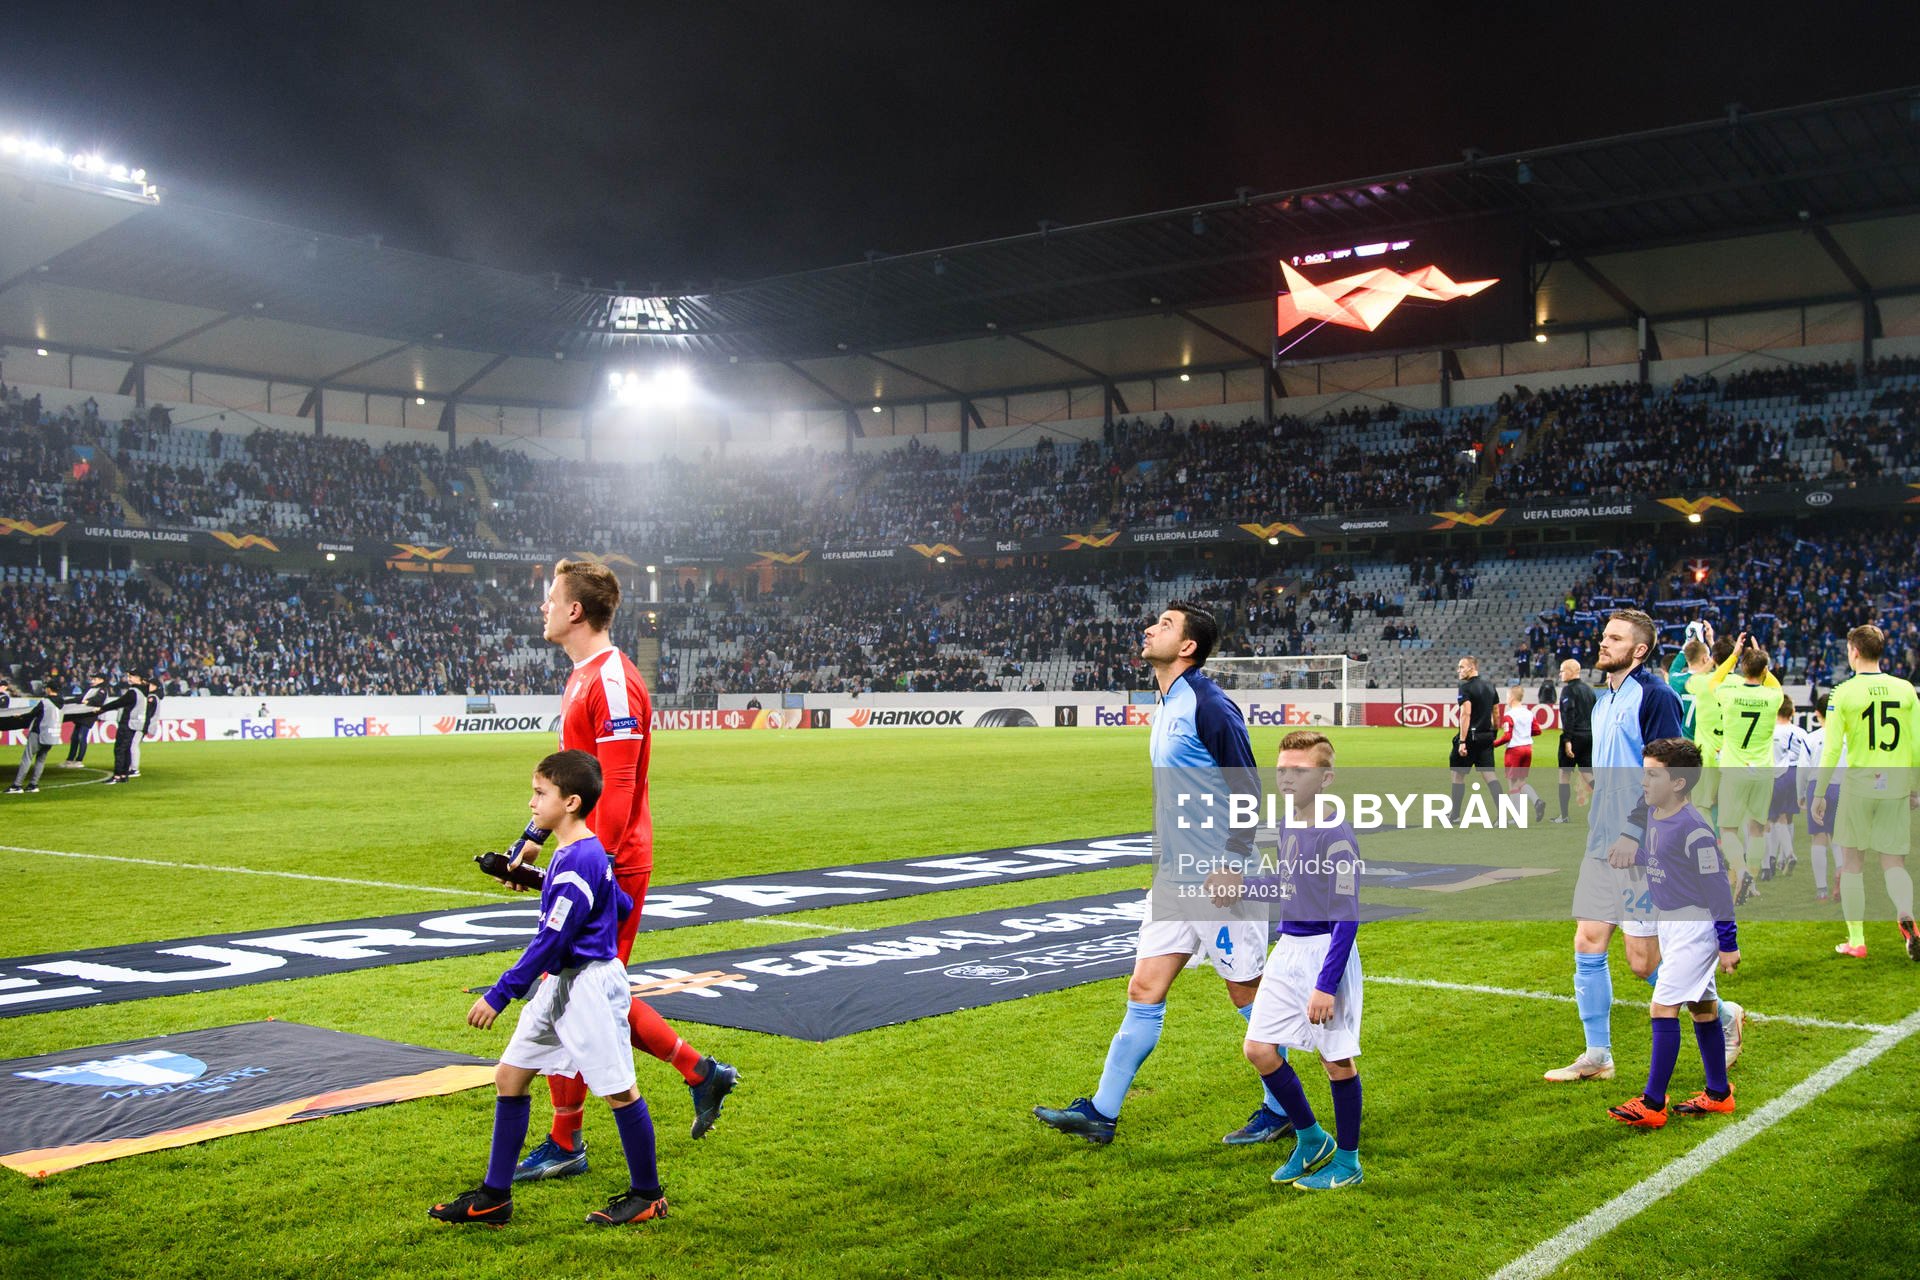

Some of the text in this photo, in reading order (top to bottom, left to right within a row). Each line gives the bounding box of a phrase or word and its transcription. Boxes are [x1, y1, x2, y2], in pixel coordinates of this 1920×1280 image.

[1523, 505, 1632, 520] UEFA EUROPA LEAGUE
[85, 527, 188, 542] UEFA EUROPA LEAGUE
[1134, 529, 1220, 542] UEFA EUROPA LEAGUE
[467, 551, 553, 562] UEFA EUROPA LEAGUE
[822, 549, 895, 560] UEFA EUROPA LEAGUE
[1867, 686, 1889, 697] VETTI
[613, 719, 638, 727] RESPECT
[651, 711, 722, 730] AMSTEL
[1095, 705, 1150, 726] FedEx
[1250, 703, 1311, 726] FedEx
[87, 718, 198, 744] MOORS
[240, 718, 301, 739] FedEx
[334, 716, 390, 737] FedEx
[1740, 711, 1761, 750] 7
[1861, 700, 1901, 752] 15
[1623, 888, 1653, 914] 24
[1215, 925, 1234, 956] 4
